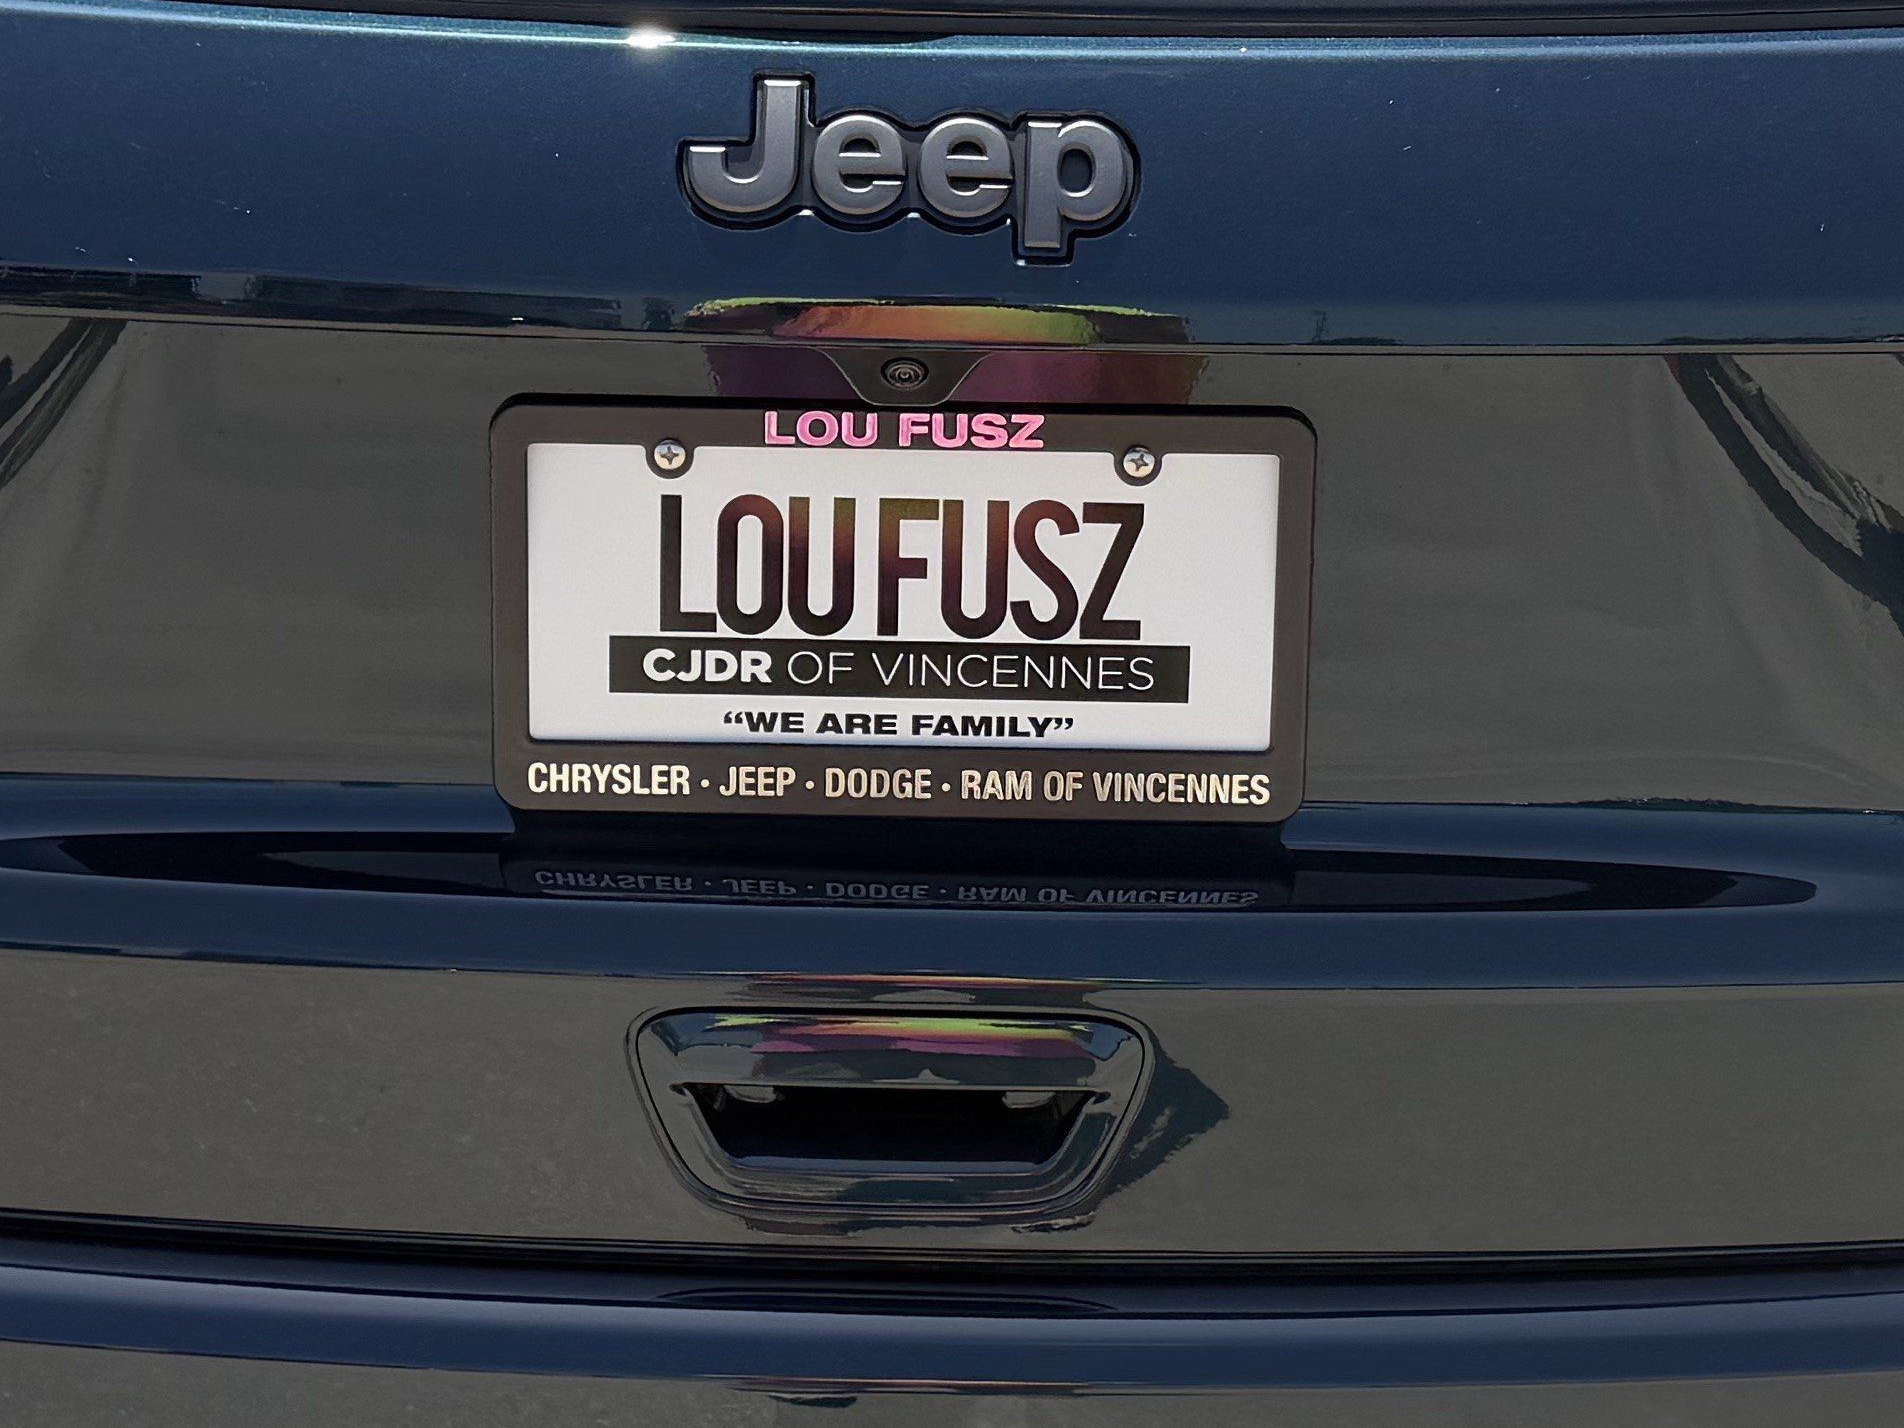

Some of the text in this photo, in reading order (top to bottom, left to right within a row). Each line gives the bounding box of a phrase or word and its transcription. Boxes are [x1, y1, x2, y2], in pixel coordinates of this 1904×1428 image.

[680, 75, 1139, 264] Jeep
[764, 410, 1045, 448] LOU FUSZ
[642, 648, 1155, 692] CJDR OF VINCENNES
[815, 713, 897, 735] ARE
[527, 762, 1272, 806] CHRYSLER JEEP DODGE RAM OF VINCENNES
